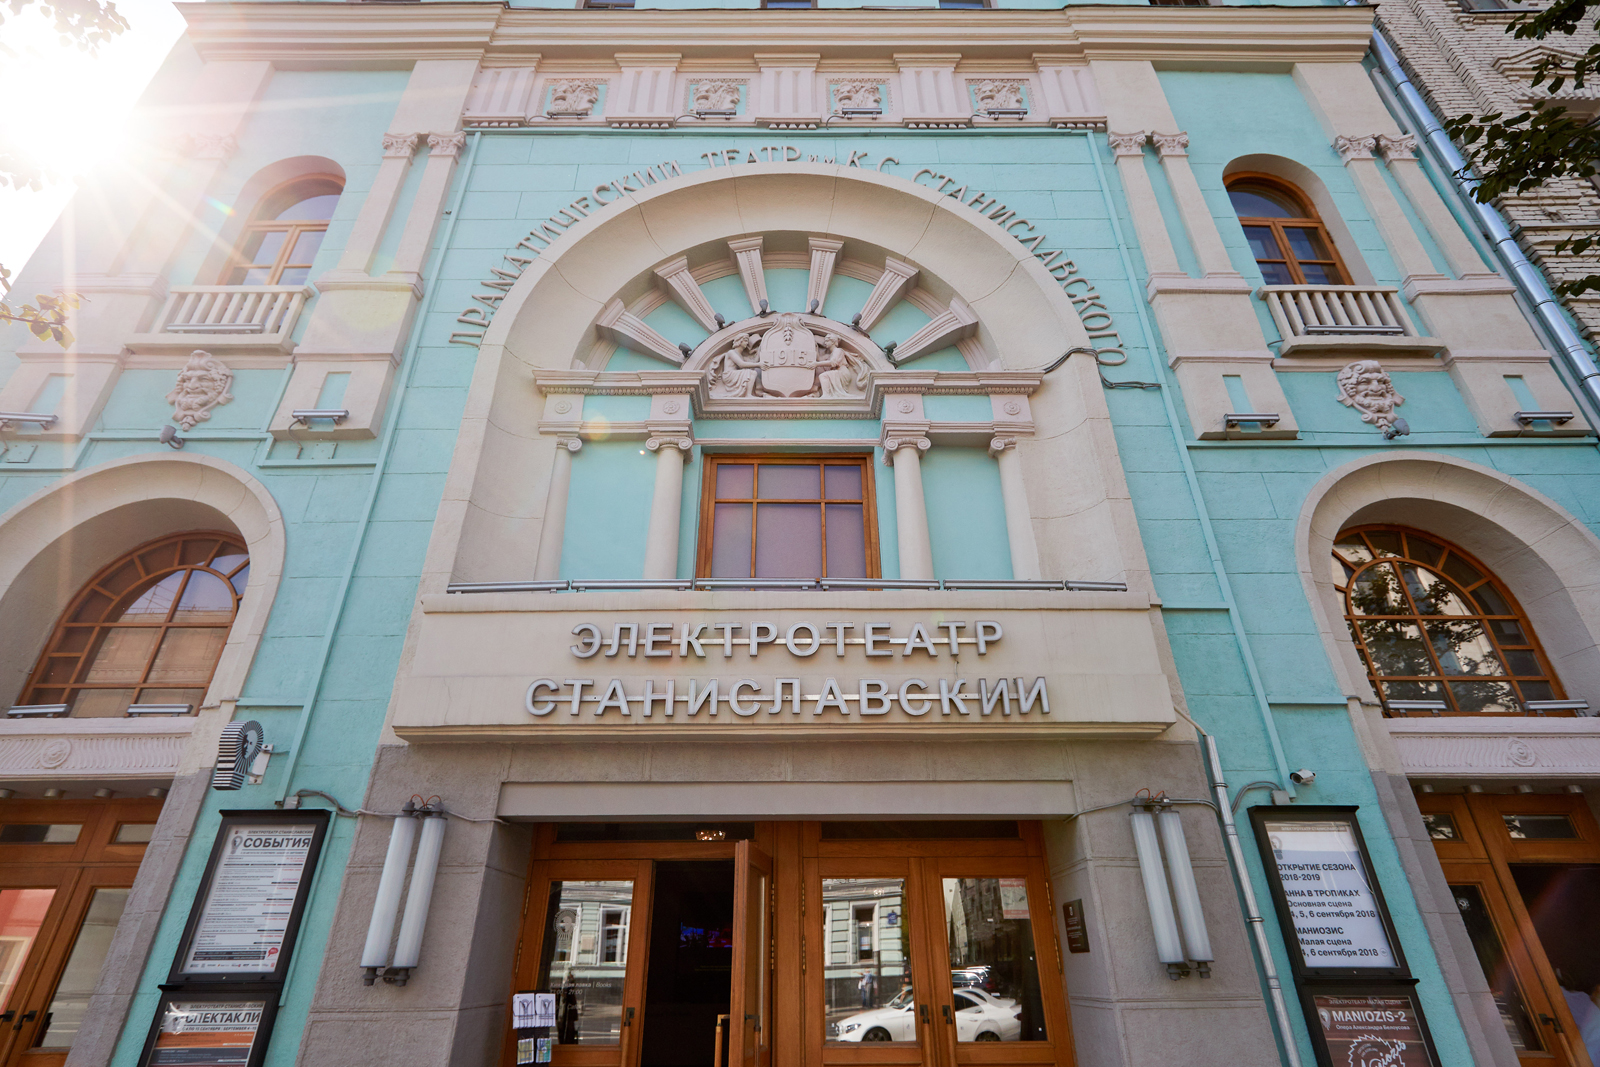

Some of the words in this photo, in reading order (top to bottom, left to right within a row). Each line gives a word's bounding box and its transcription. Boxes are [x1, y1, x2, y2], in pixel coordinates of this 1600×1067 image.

[701, 145, 802, 169] ТЕАТР
[845, 150, 868, 169] К
[911, 168, 1128, 365] СТАНИСЛАВСКОГО
[770, 349, 808, 367] 1915
[569, 620, 1003, 658] ЭЛЕКТРОТЕАТР
[243, 837, 311, 848] СОБЫТИЯ
[1278, 863, 1320, 871] ОТКРЫТИЕ
[1316, 911, 1355, 919] сентября
[1317, 949, 1358, 958] сентября
[185, 1012, 261, 1024] СПЕКТАКЛИ
[1331, 1011, 1407, 1022] MANIOZIS-2
